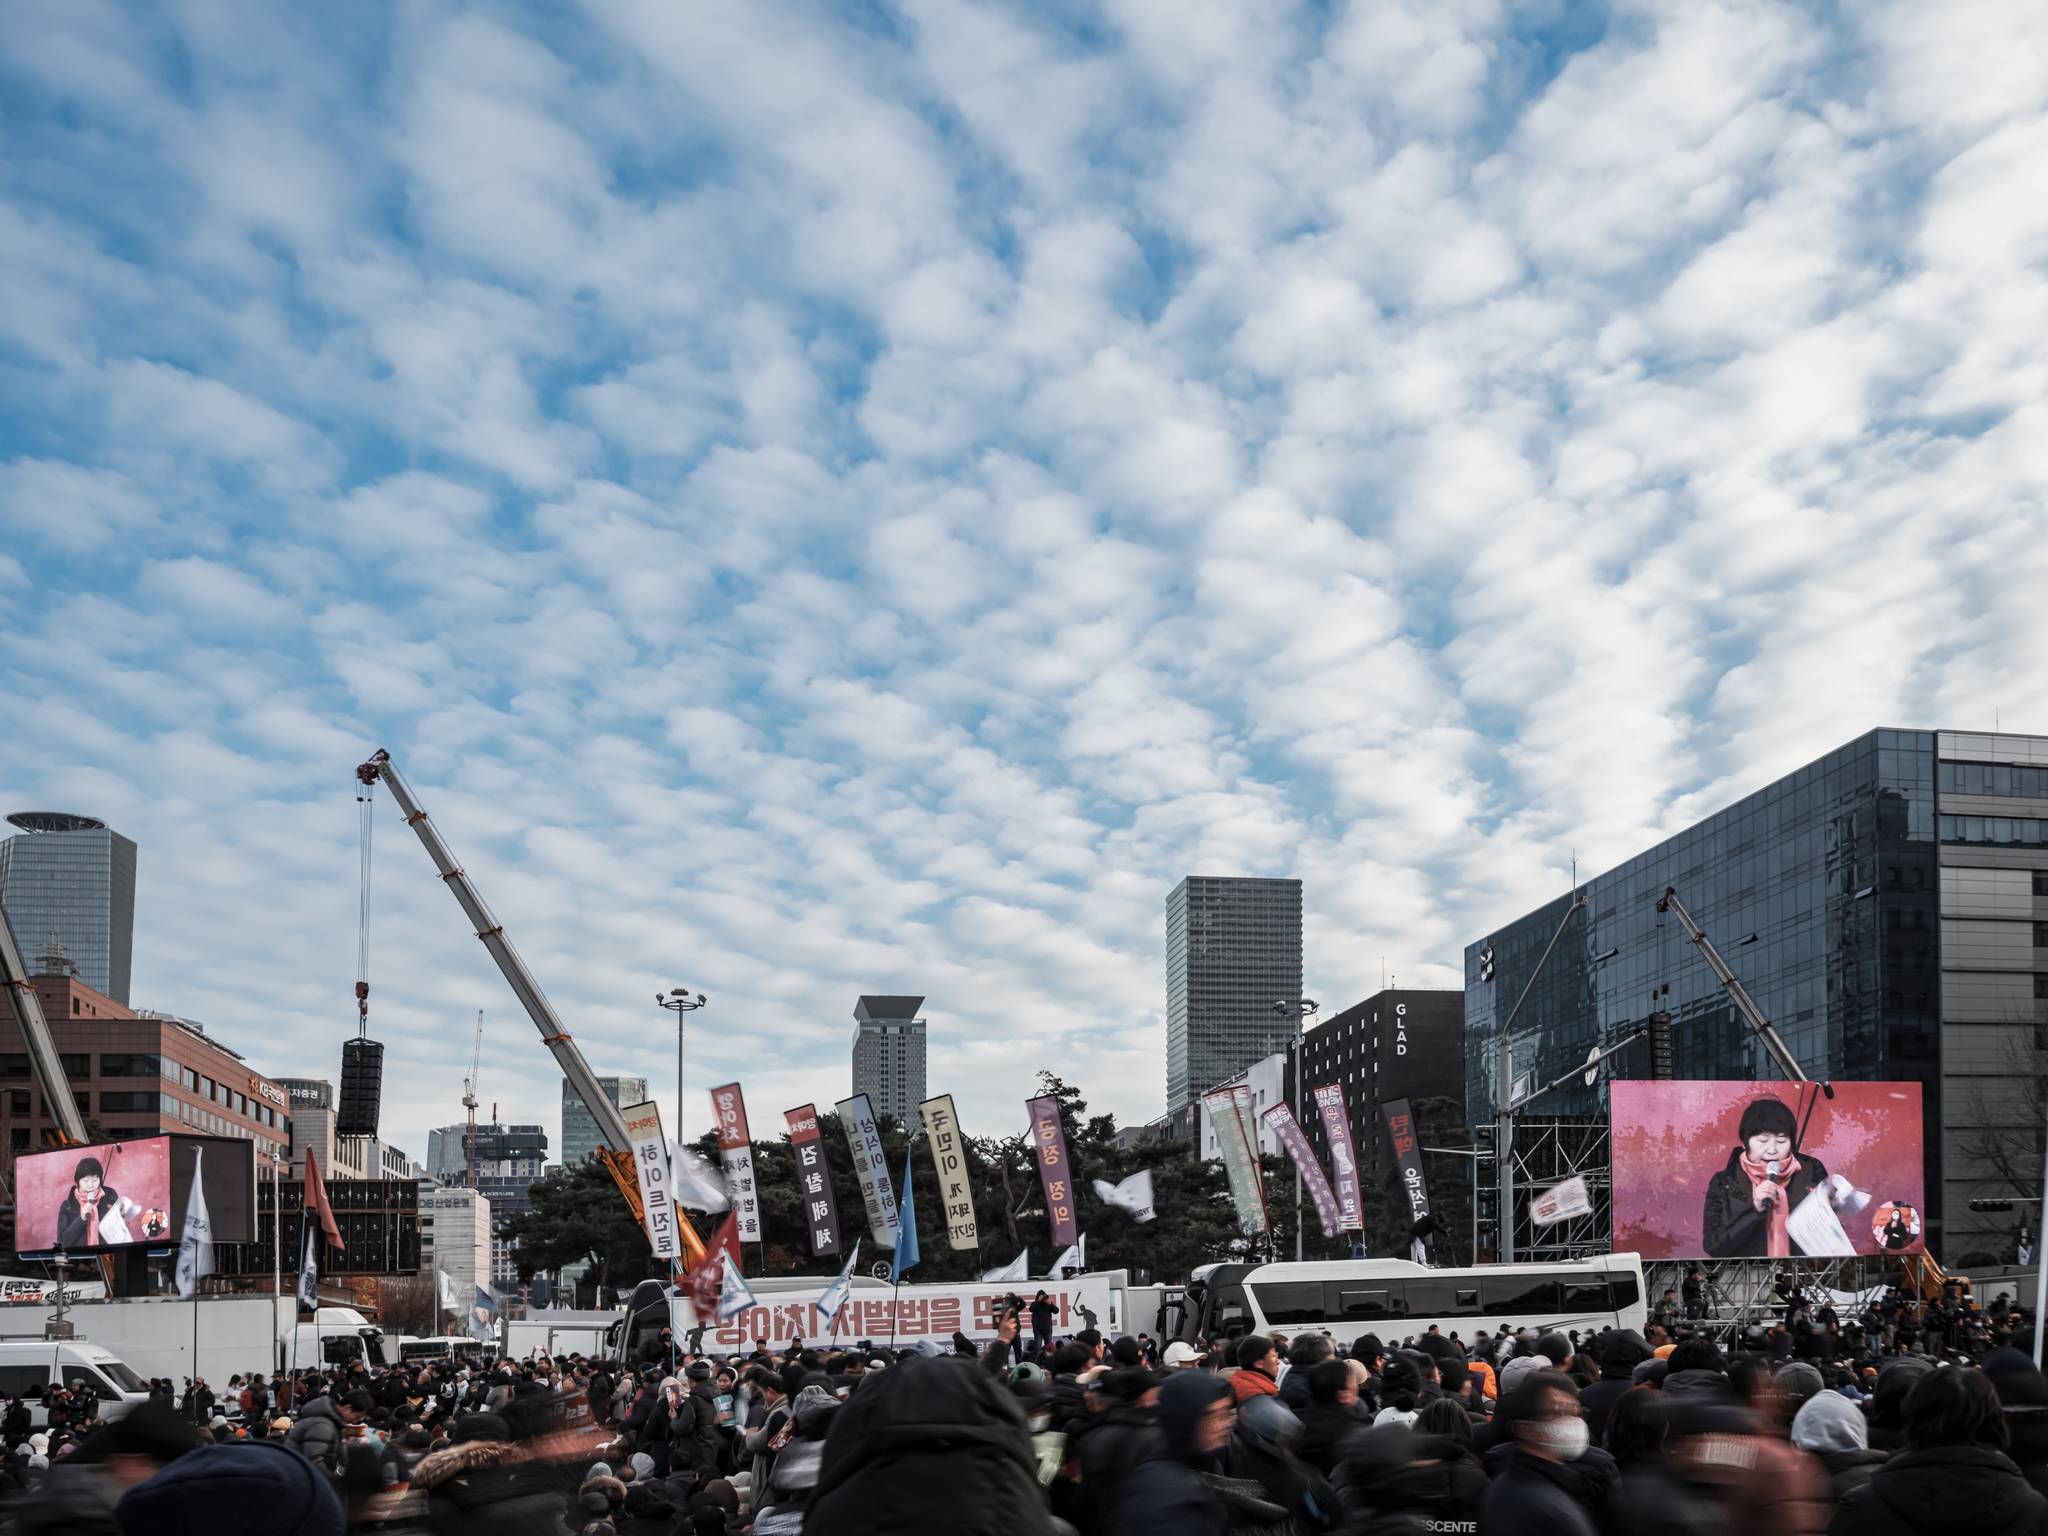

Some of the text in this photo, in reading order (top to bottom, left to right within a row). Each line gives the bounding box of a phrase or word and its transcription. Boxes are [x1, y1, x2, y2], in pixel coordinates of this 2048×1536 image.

[1395, 1003, 1407, 1056] GLAD
[288, 1088, 319, 1101] 자증권
[714, 1303, 818, 1345] 양아치
